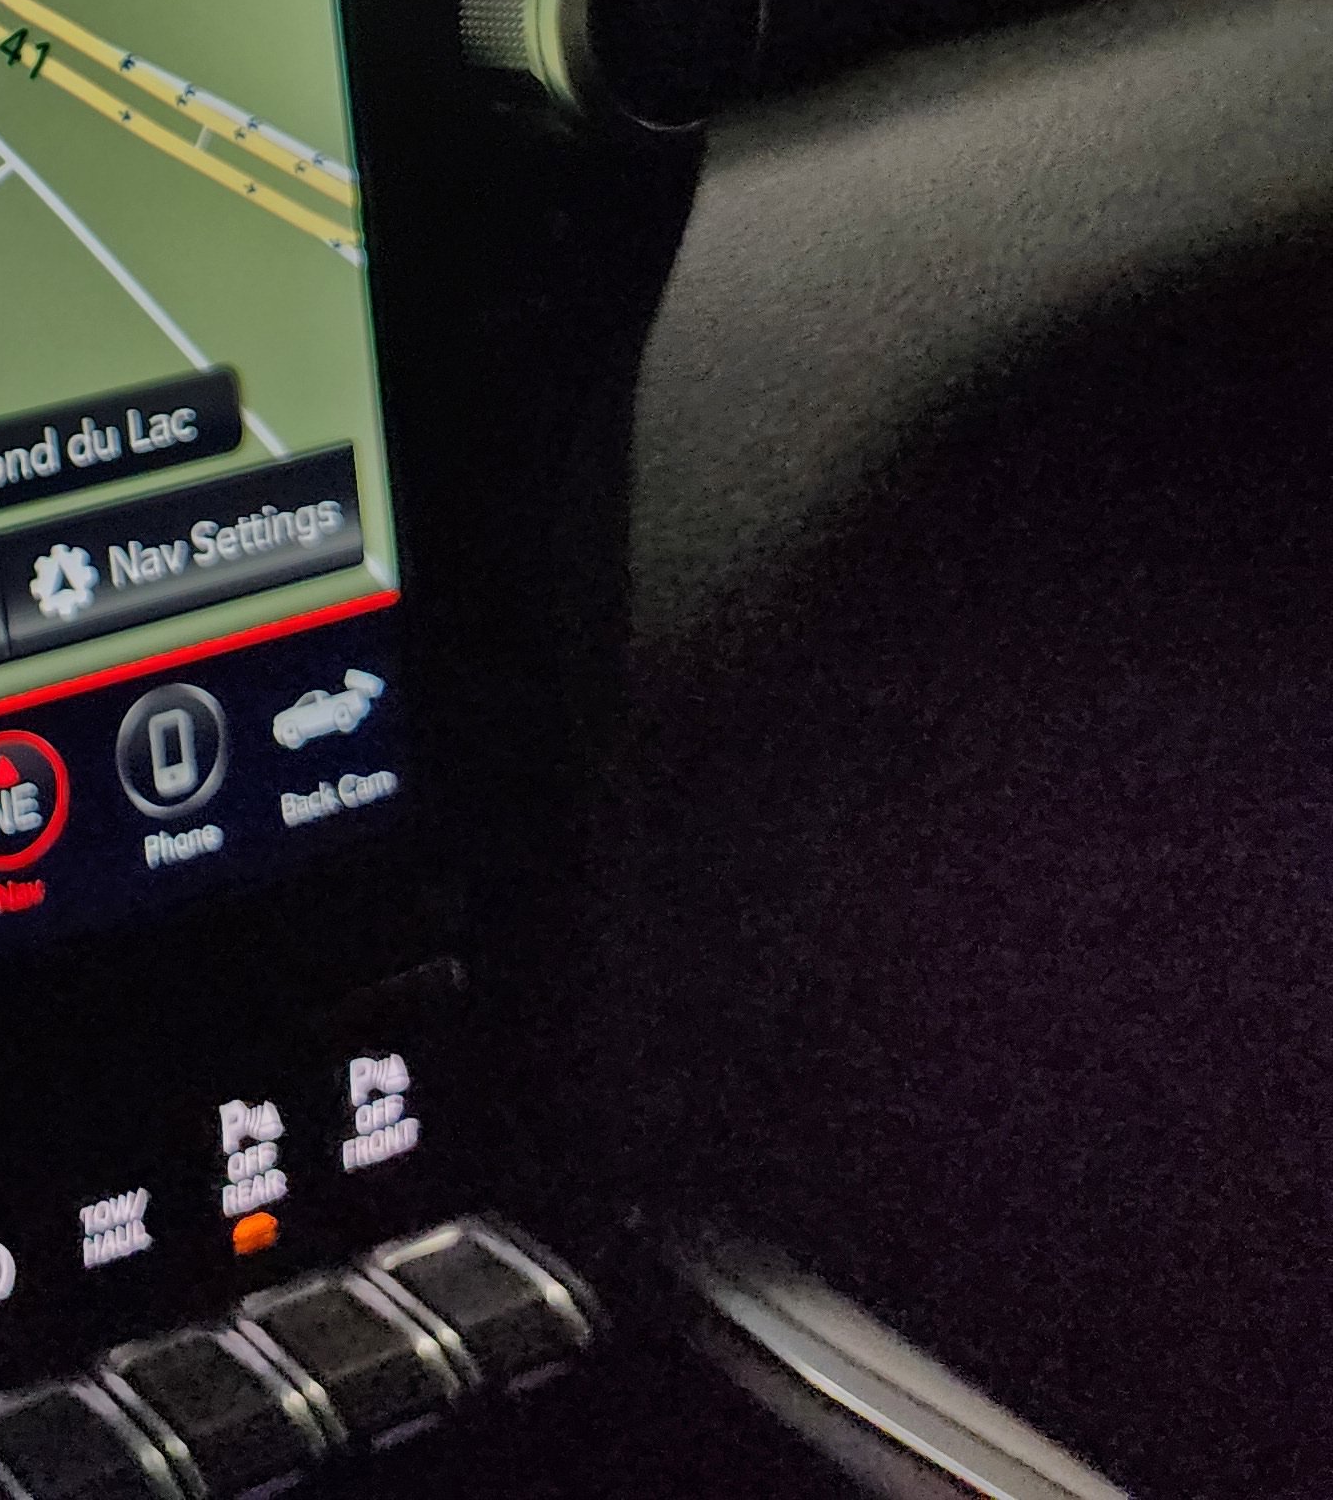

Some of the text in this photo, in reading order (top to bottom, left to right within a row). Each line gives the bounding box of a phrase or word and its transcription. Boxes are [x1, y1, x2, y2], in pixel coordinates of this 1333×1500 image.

[67, 417, 120, 468] du
[126, 407, 197, 454] Lac
[108, 500, 343, 588] Nav Settings
[281, 781, 341, 828] Back
[144, 825, 225, 870] Phone
[223, 1169, 288, 1217] REAR
[83, 1219, 153, 1268] HAUL
